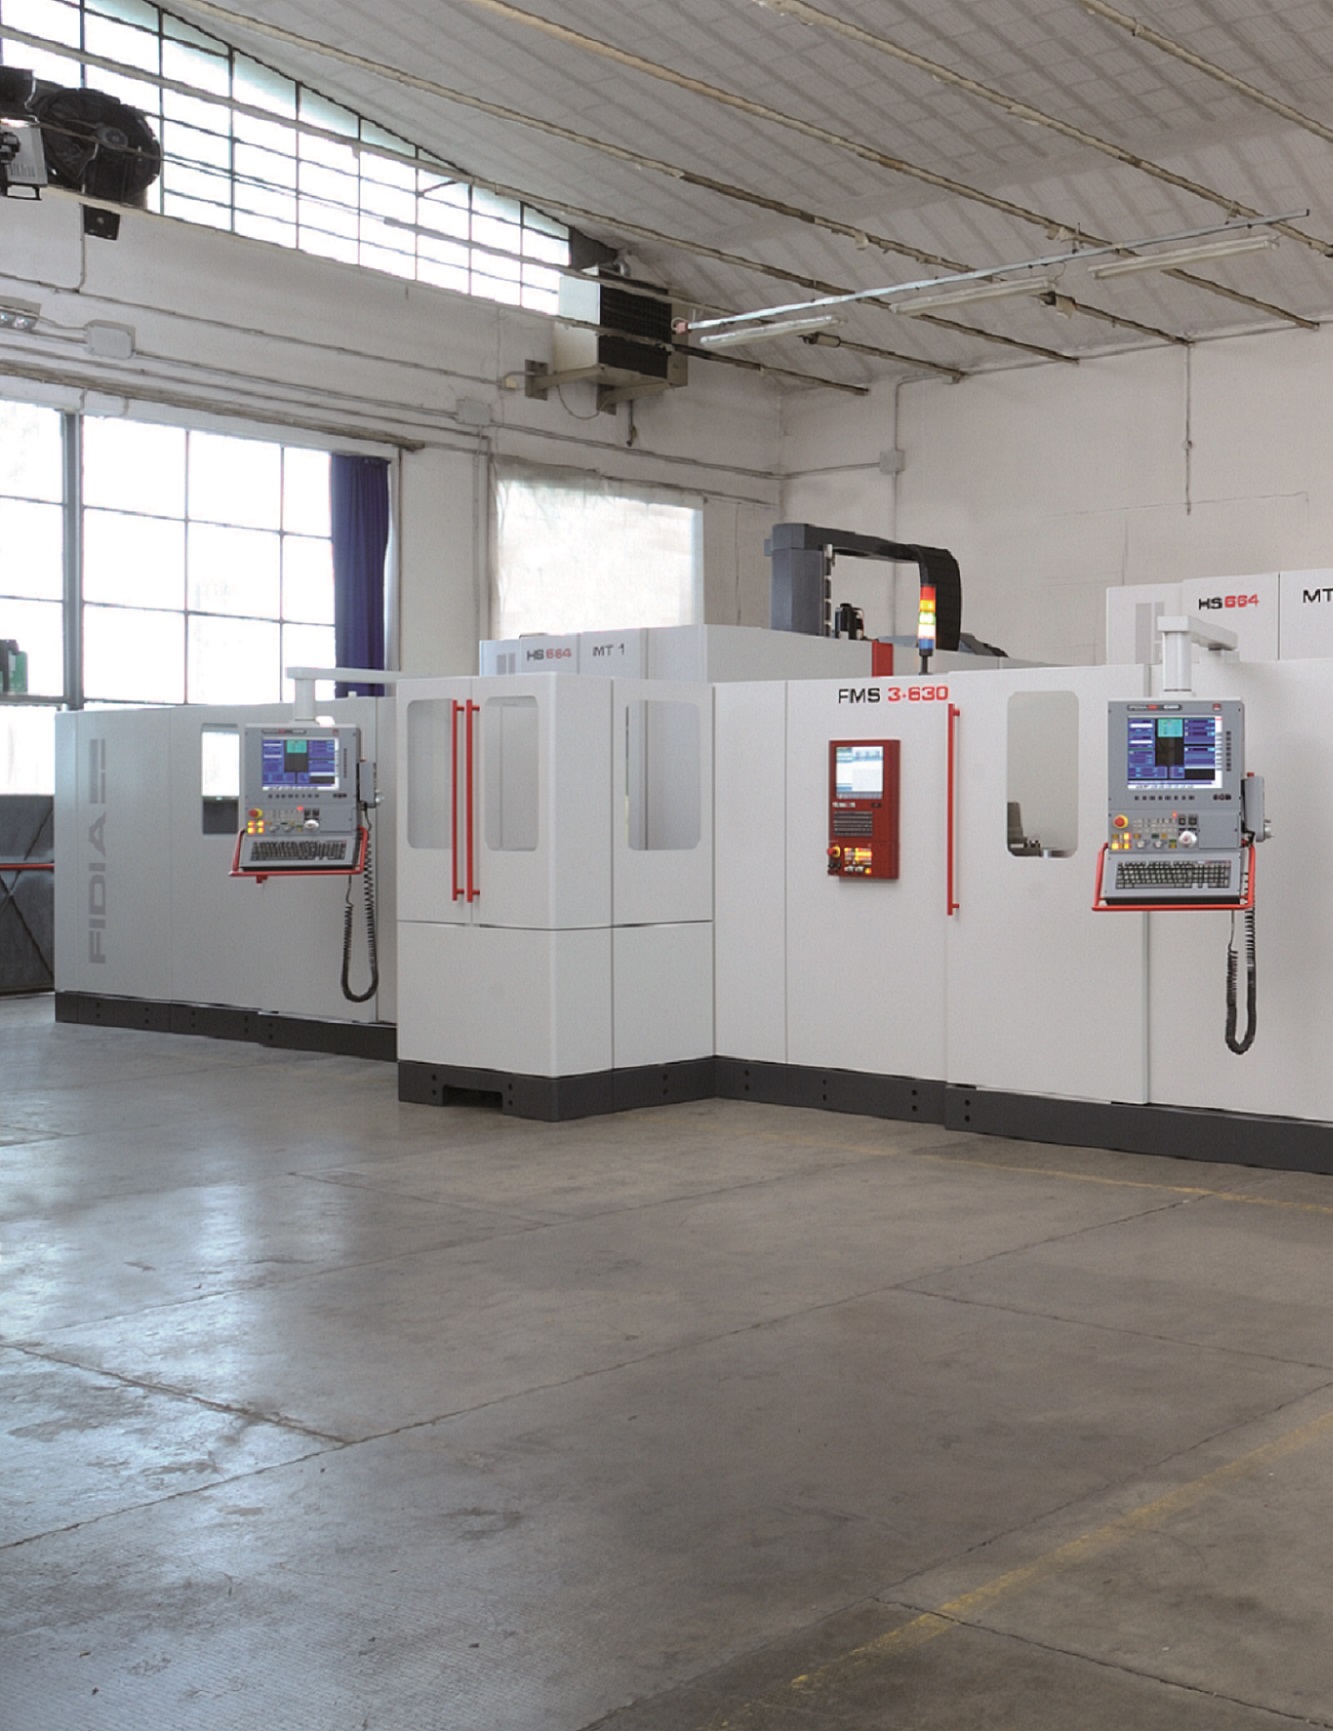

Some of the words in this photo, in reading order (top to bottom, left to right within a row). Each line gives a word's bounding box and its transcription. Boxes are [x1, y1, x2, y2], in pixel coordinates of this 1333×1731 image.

[592, 644, 614, 657] MT
[618, 643, 625, 654] 1
[838, 687, 881, 704] FMS
[88, 811, 106, 964] FIDIA
